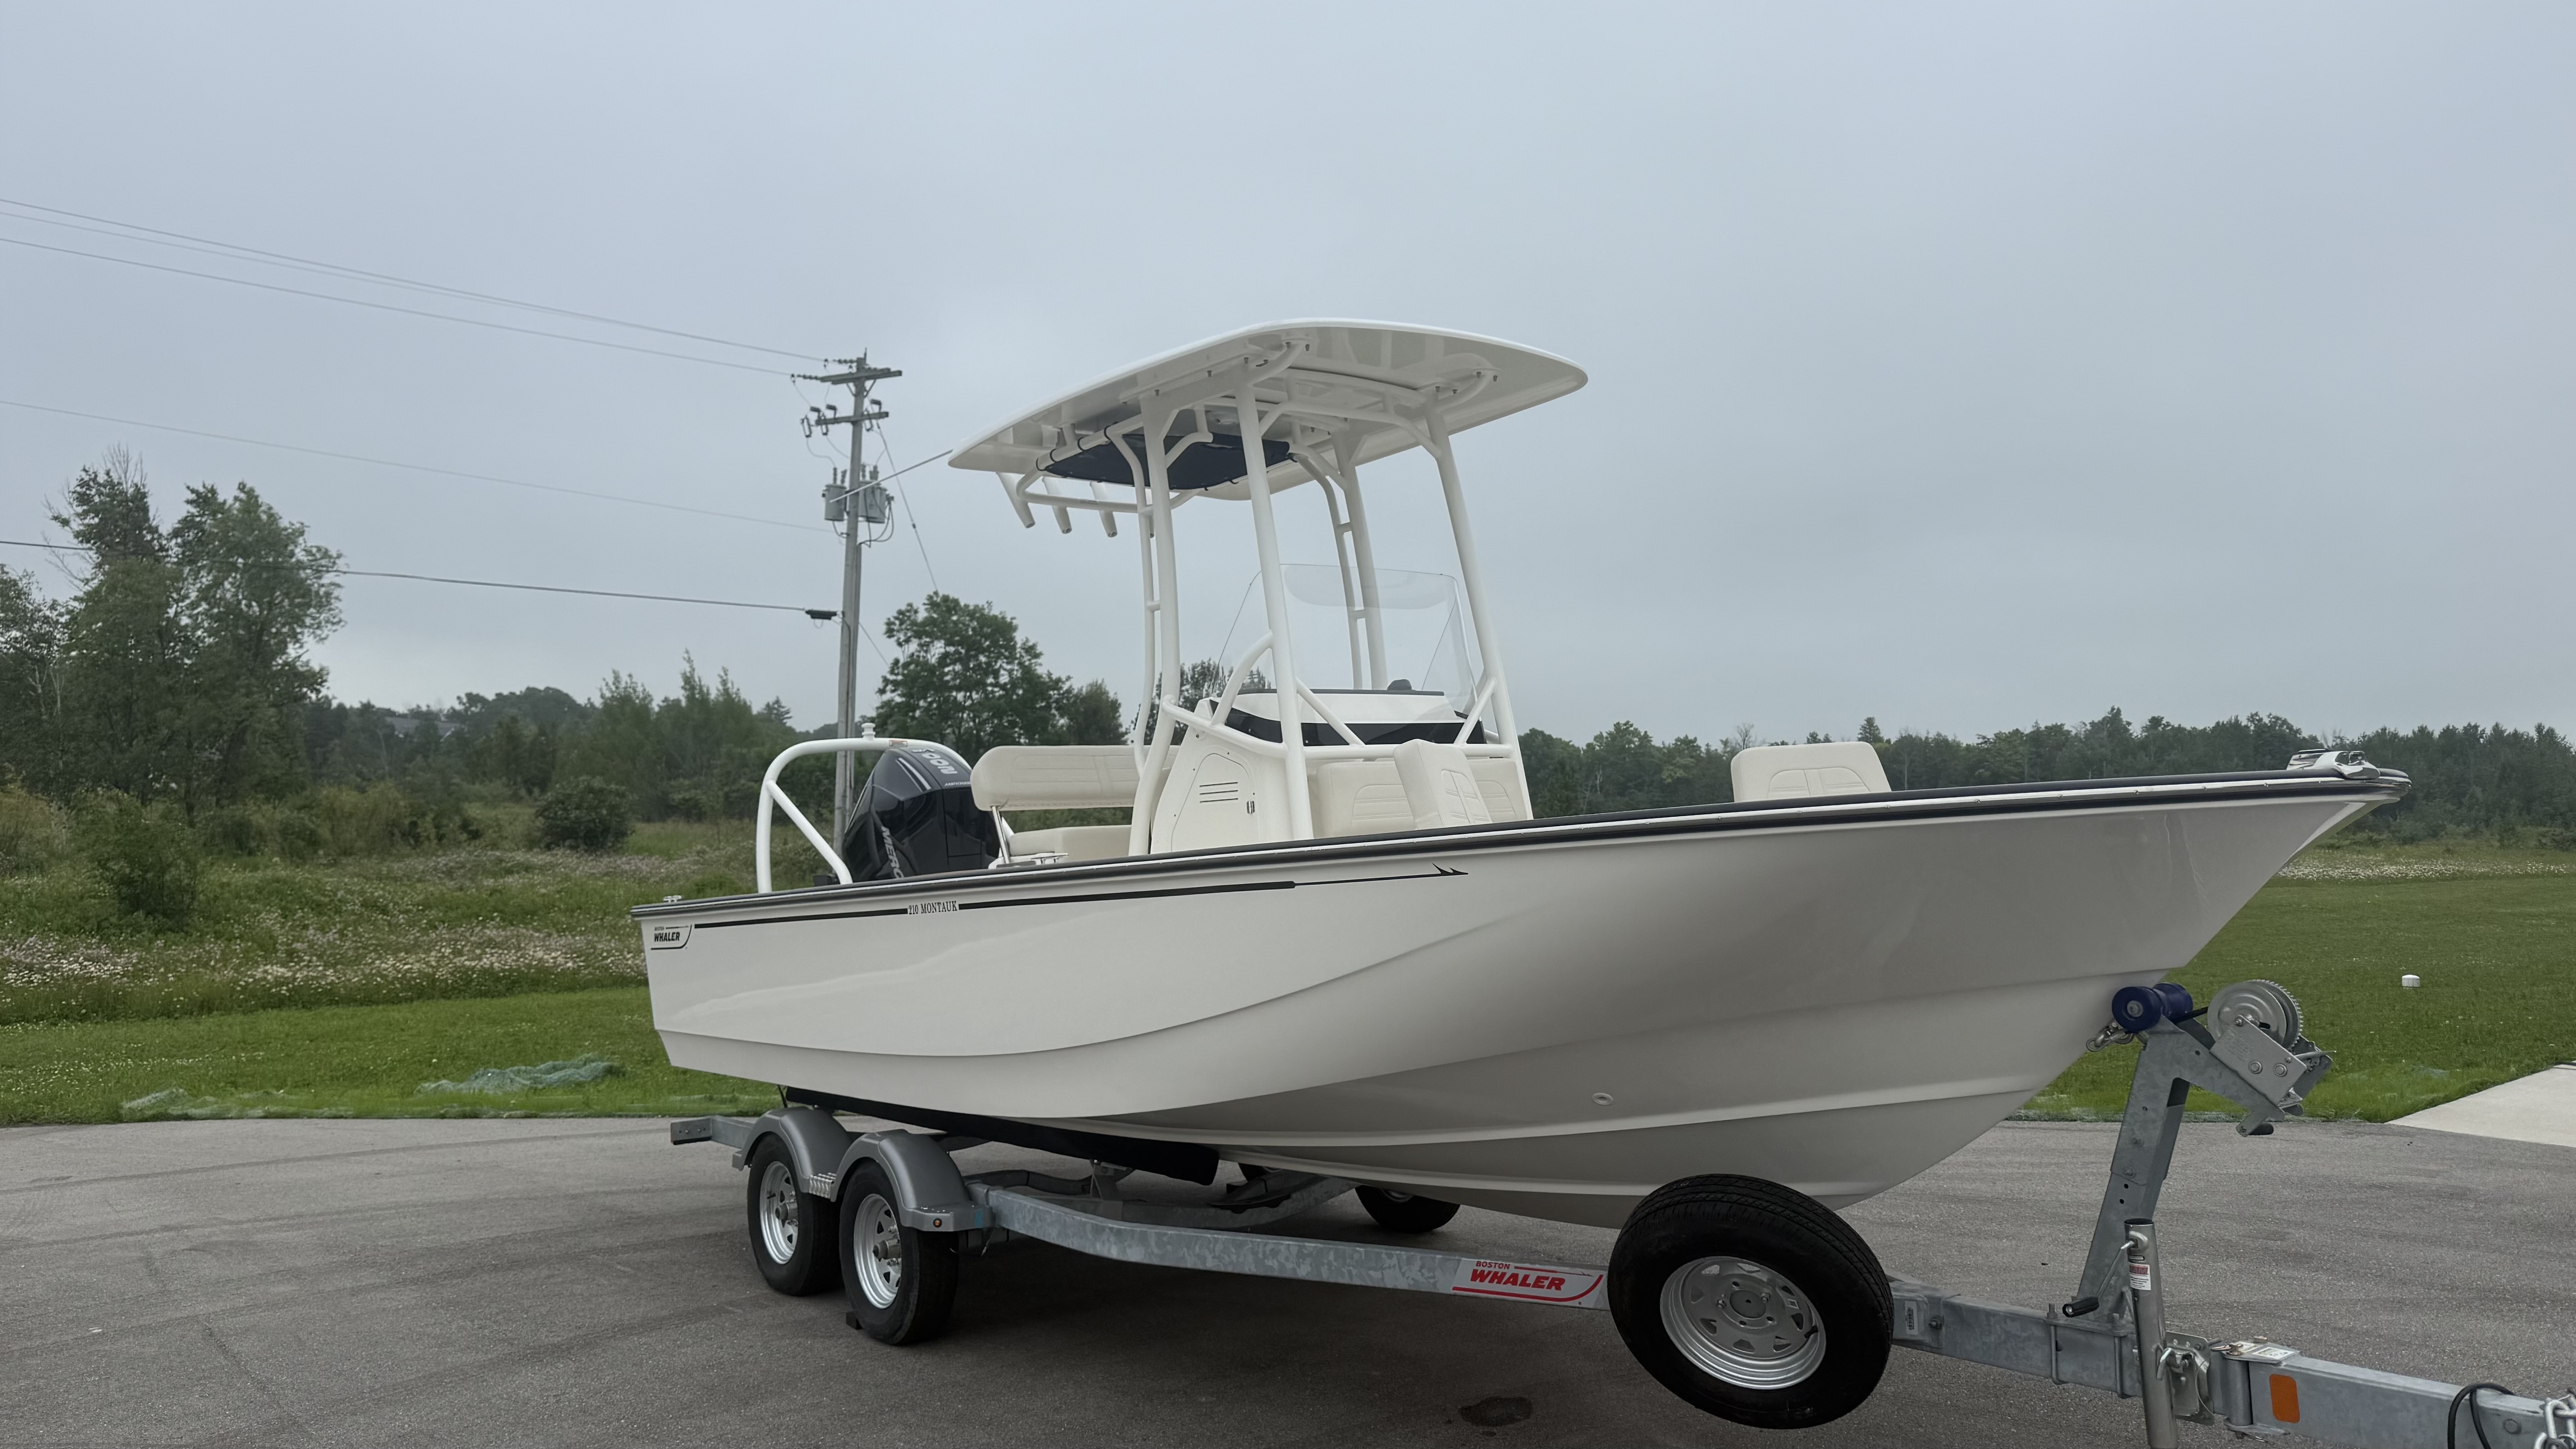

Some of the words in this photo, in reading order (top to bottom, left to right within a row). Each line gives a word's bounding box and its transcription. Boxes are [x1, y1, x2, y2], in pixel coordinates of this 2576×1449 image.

[909, 905, 918, 915] 210
[921, 901, 957, 914] MONTAUK
[654, 932, 680, 942] WHALER
[1476, 1260, 1510, 1270] BOSTON
[1470, 1268, 1565, 1291] WHALER
